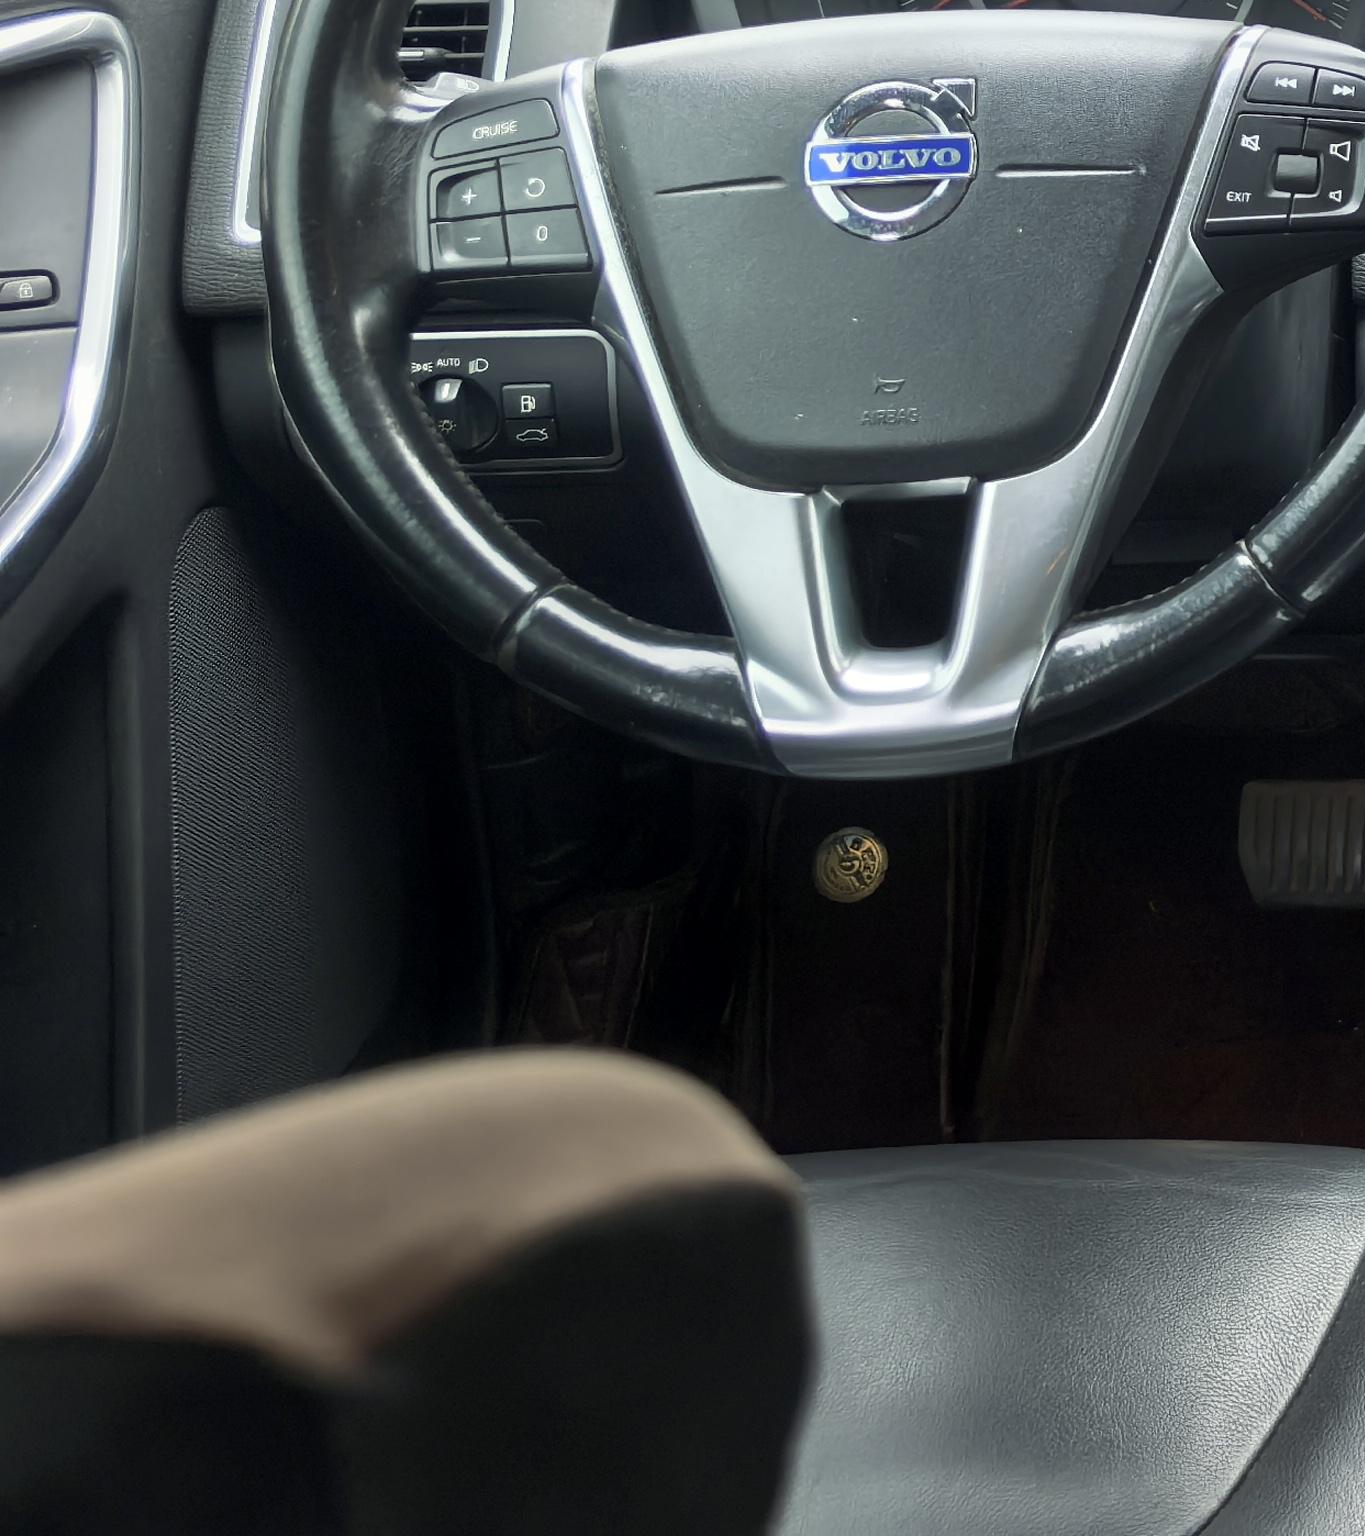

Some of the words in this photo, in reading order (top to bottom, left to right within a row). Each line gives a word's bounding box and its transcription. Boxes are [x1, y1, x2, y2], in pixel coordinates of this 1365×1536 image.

[472, 120, 518, 141] CRUISE
[819, 147, 962, 173] VOLVO
[1226, 191, 1252, 203] EXIT
[436, 356, 462, 368] AUTO
